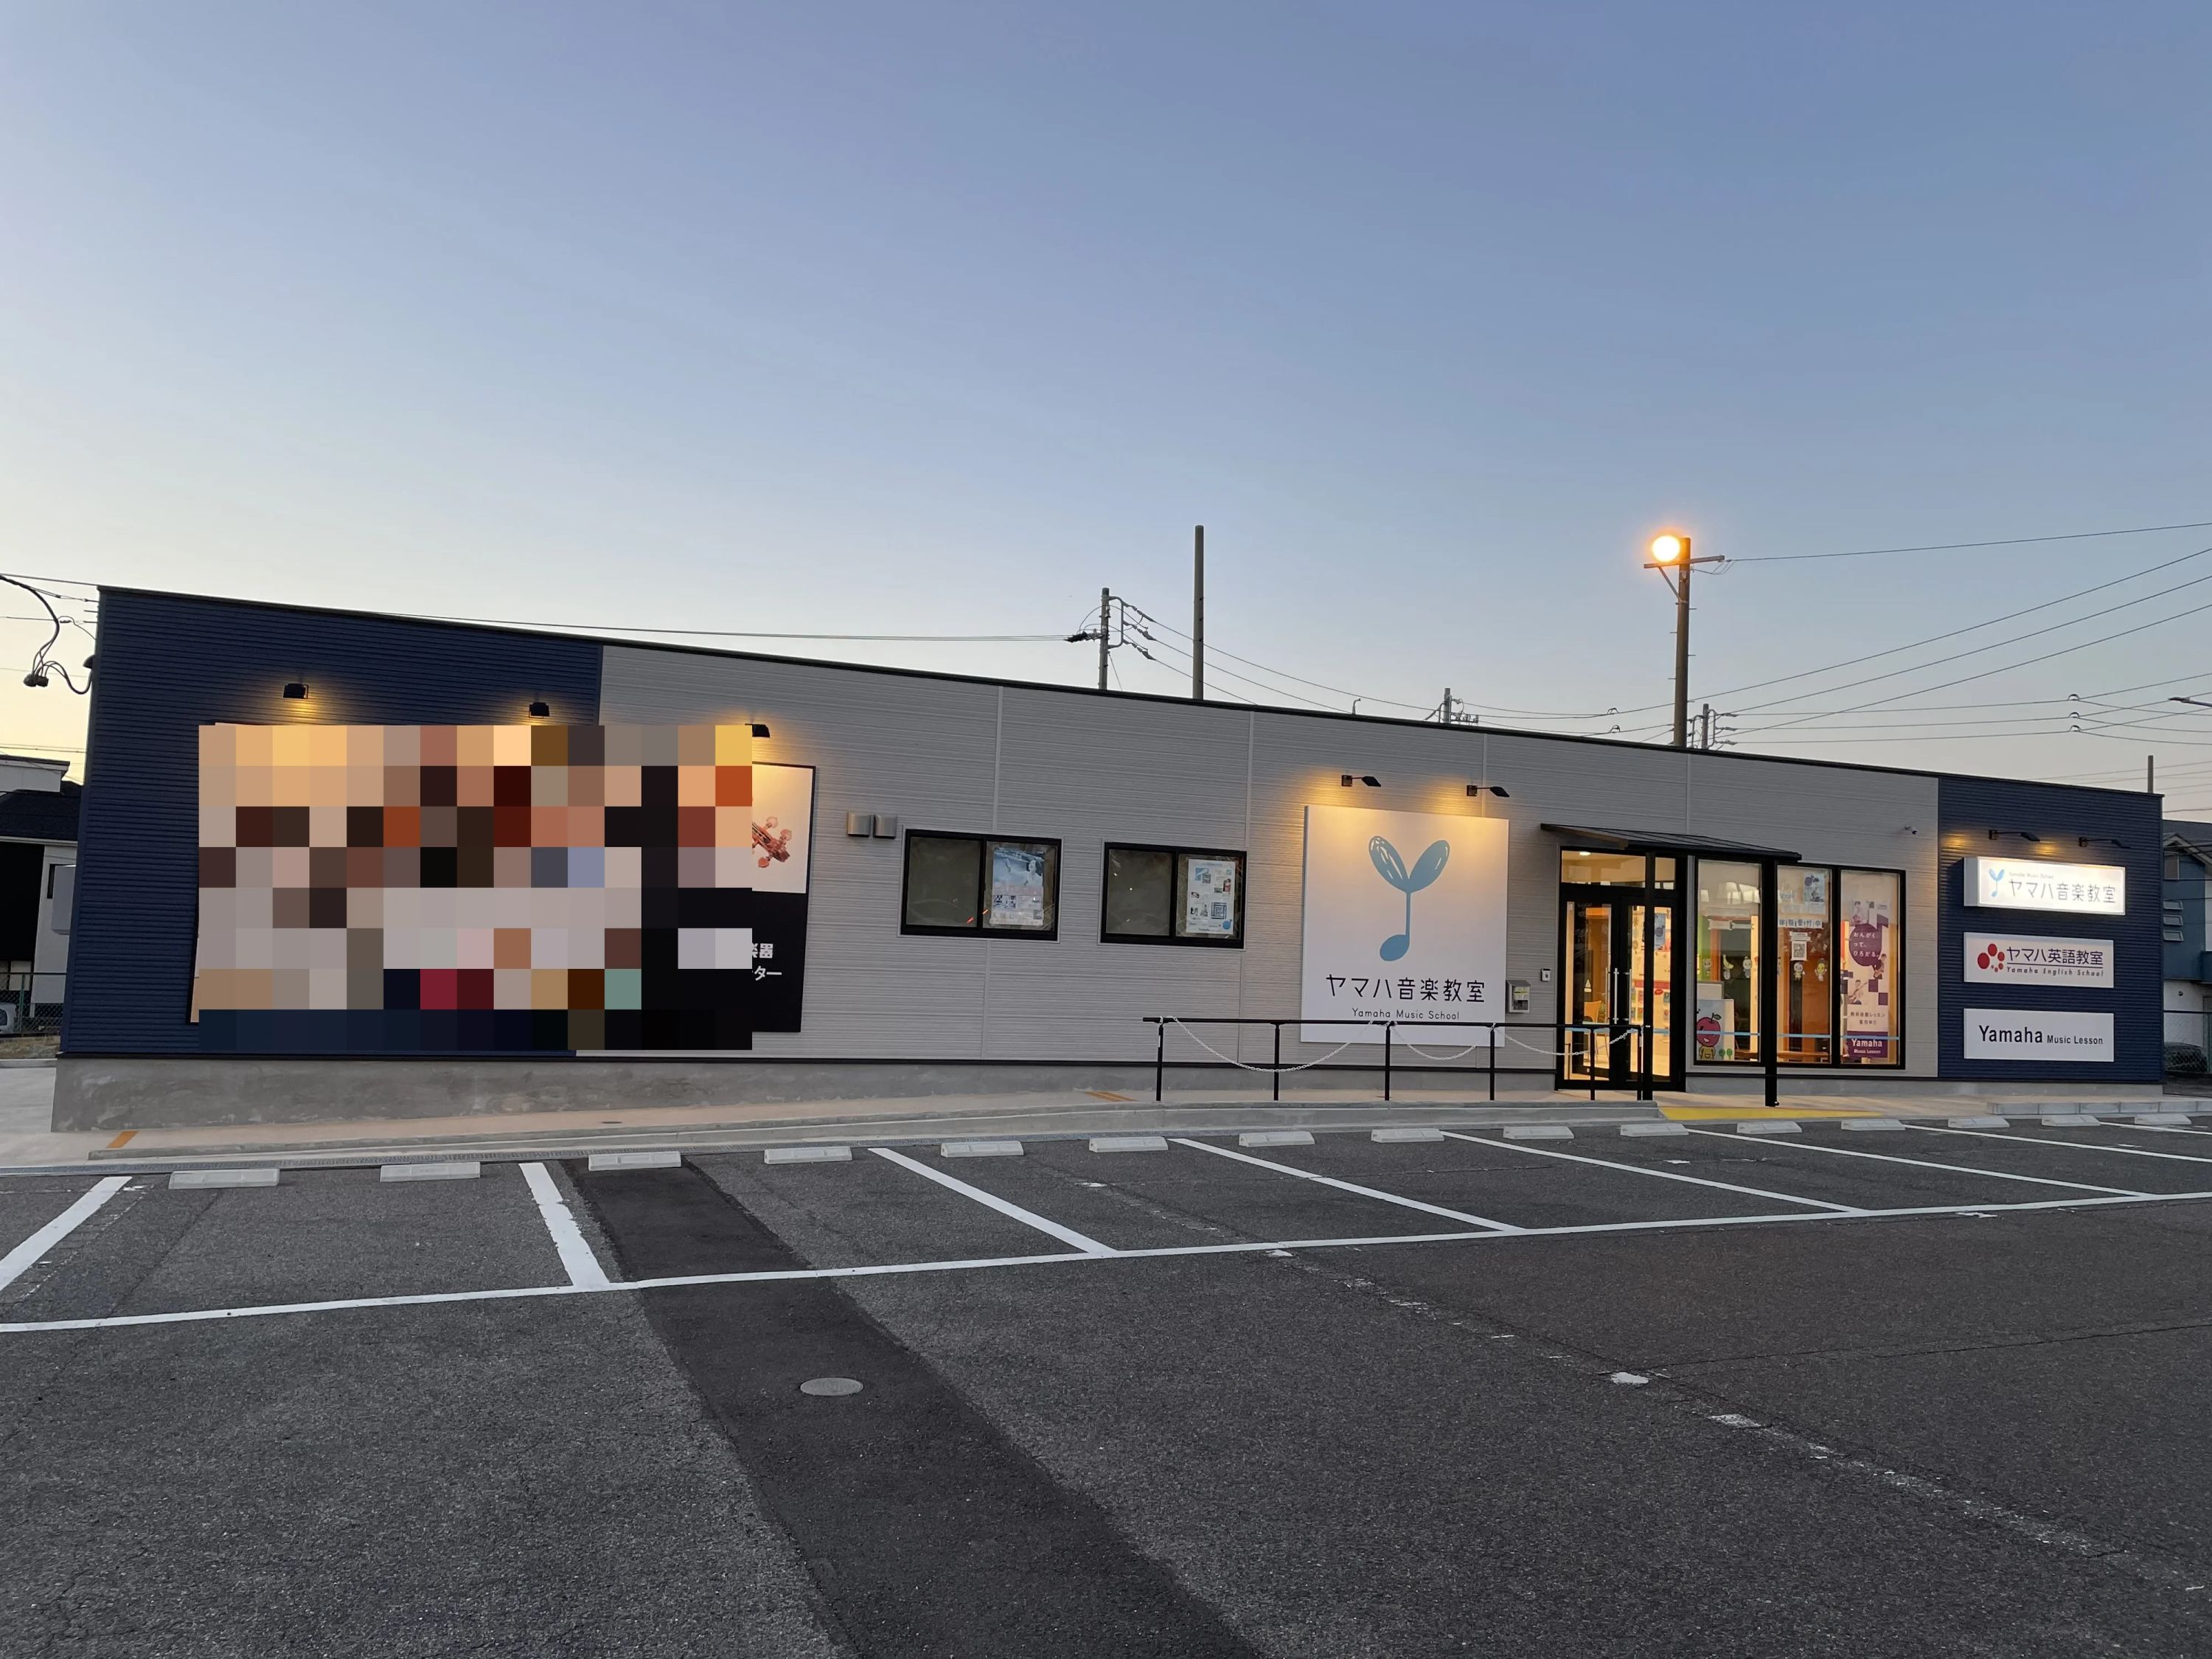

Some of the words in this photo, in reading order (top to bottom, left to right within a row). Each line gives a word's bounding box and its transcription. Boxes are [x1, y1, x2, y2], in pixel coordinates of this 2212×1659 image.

[2008, 879, 2115, 903] ヤマハ音楽教室
[2006, 946, 2104, 965] ヤマハ英語教室
[752, 965, 782, 981] ター
[2043, 968, 2073, 976] English
[1326, 974, 1485, 1003] ヤマハ音楽教室
[1352, 1008, 1391, 1018] Yamaha
[1396, 1009, 1424, 1019] Music
[1428, 1010, 1459, 1020] School
[1851, 1038, 1882, 1047] Yamaha
[1979, 1025, 2042, 1043] Yamaha
[2047, 1034, 2071, 1044] Music
[2074, 1036, 2103, 1045] Lesson
